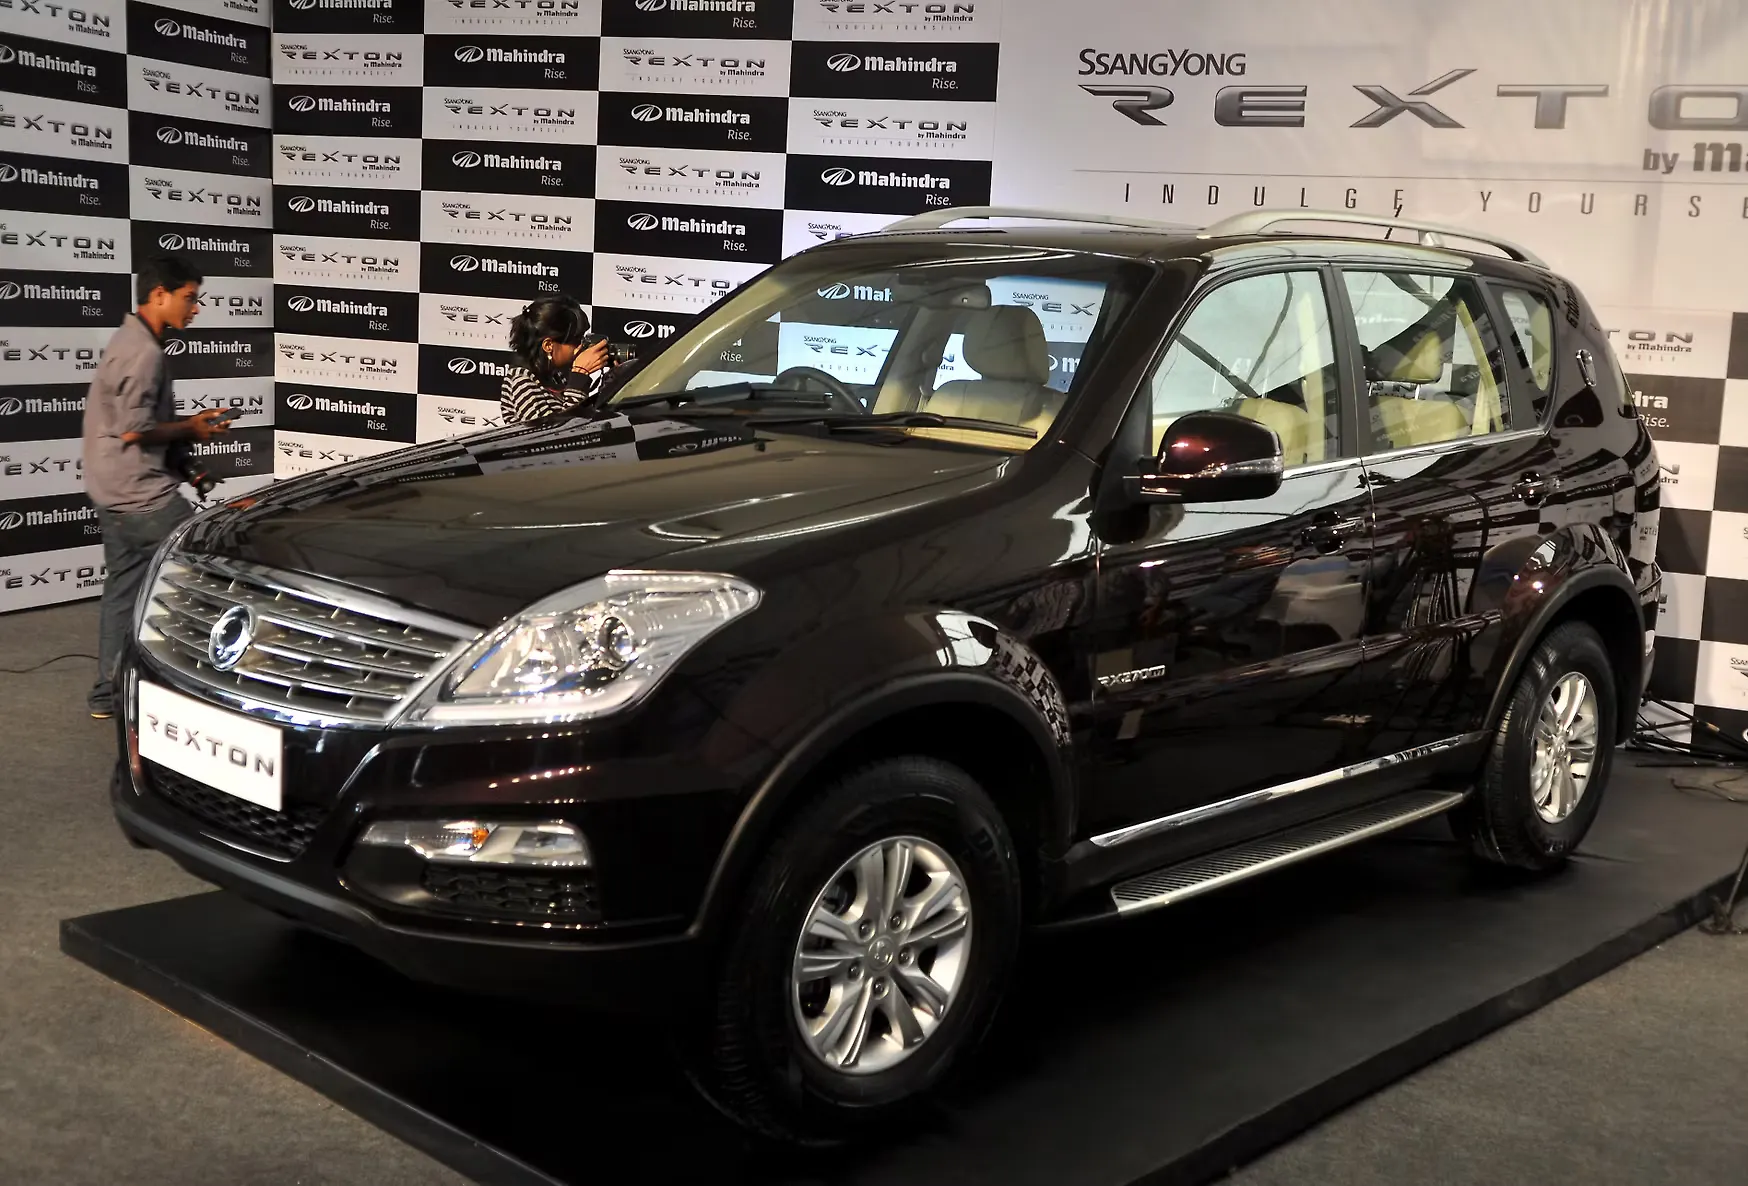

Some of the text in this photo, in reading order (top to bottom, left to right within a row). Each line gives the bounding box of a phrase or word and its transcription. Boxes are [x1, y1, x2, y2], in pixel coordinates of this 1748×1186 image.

[447, 0, 579, 9] REXTON
[670, 0, 755, 12] Mahindra
[819, 0, 974, 13] REXTON
[0, 0, 110, 27] EXTON
[373, 13, 394, 23] Rise.
[732, 17, 757, 28] Rise.
[182, 24, 247, 48] Mahindra
[230, 52, 249, 64] Rise.
[281, 48, 402, 60] REXTON
[486, 48, 565, 64] Mahindra
[623, 54, 765, 68] REXTON
[18, 50, 96, 76] Mahindra
[864, 56, 957, 72] Mahindra
[544, 68, 567, 79] Rise.
[77, 80, 99, 93] Rise.
[932, 78, 959, 89] Rise.
[143, 78, 259, 105] REXTON
[1077, 68, 1748, 130] REXTO
[318, 98, 390, 112] Mahindra
[444, 103, 575, 117] REXTON
[371, 117, 393, 127] Rise.
[665, 107, 750, 124] Mahindra
[0, 115, 112, 140] EXTON
[813, 116, 967, 131] REXTON
[184, 131, 248, 152] Mahindra
[727, 129, 752, 140] Rise.
[232, 155, 250, 166] Rise.
[280, 150, 400, 164] REXTON
[484, 154, 562, 170] Mahindra
[1642, 148, 1679, 174] by
[21, 168, 98, 190] Mahindra
[619, 164, 761, 180] REXTON
[541, 175, 564, 186] Rise.
[722, 180, 760, 188] Mahindra
[858, 171, 950, 189] Mahindra
[79, 193, 101, 206] Rise.
[145, 188, 260, 207] REXTON
[925, 193, 952, 206] Rise.
[1125, 183, 1748, 219] INDULGE YOURSE
[317, 199, 389, 215] Mahindra
[442, 208, 572, 224] REXTON
[370, 219, 391, 230] Rise.
[661, 216, 746, 235] Mahindra
[1, 230, 114, 250] EXTON
[186, 236, 250, 252] Mahindra
[723, 239, 748, 251] Rise.
[234, 257, 252, 268] Rise.
[280, 251, 399, 266] REXTON
[481, 258, 559, 276] Mahindra
[538, 280, 561, 292] Rise.
[616, 273, 743, 289] REXTO
[23, 284, 100, 300] Mahindra
[195, 292, 262, 307] XTON
[82, 305, 103, 316] Rise.
[316, 299, 388, 316] Mahindra
[369, 320, 390, 331] Rise.
[440, 311, 512, 325] REX
[4, 344, 104, 361] EXTO
[188, 340, 251, 354] Mahindra
[804, 342, 889, 357] REX
[1638, 343, 1692, 352] Mahindra
[235, 358, 253, 367] Rise.
[279, 350, 397, 367] REXTON
[720, 350, 744, 362] Rise.
[25, 397, 86, 413] Mahind
[175, 394, 263, 410] EXTON
[315, 397, 386, 416] Mahindra
[367, 419, 388, 430] Rise.
[438, 413, 500, 427] REX
[278, 446, 367, 462] REXT
[5, 457, 83, 476] EXT
[235, 457, 253, 467] Rise.
[83, 524, 102, 534] Rise
[5, 567, 108, 589] EXTO
[146, 713, 274, 778] REXTON
